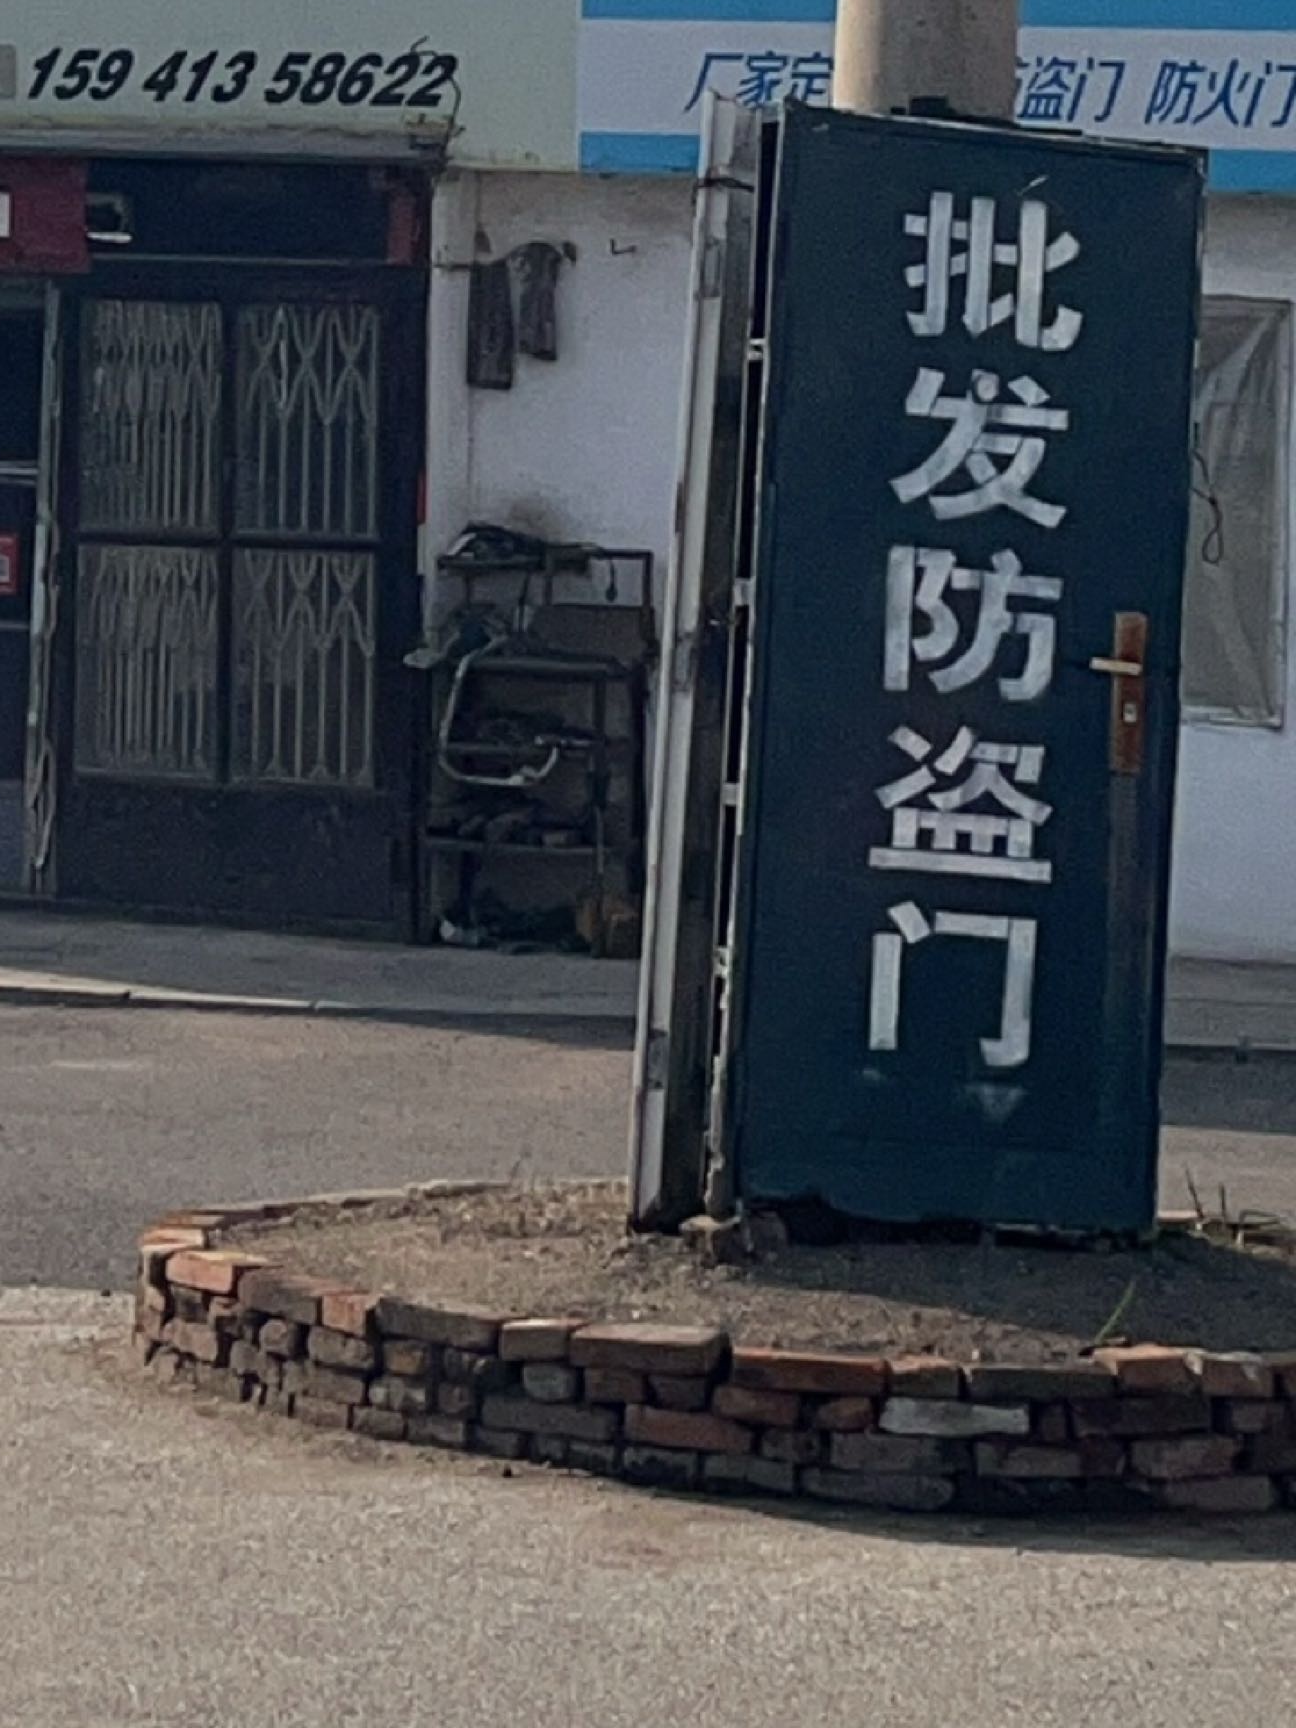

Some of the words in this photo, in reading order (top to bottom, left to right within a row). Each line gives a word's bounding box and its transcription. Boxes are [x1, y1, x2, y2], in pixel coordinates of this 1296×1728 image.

[27, 47, 134, 100] 159
[143, 51, 257, 104] 413
[264, 52, 458, 108] 58622
[1016, 56, 1126, 123] 盗门
[1144, 59, 1296, 128] 防火门
[868, 191, 1084, 1069] 批发防盗门
